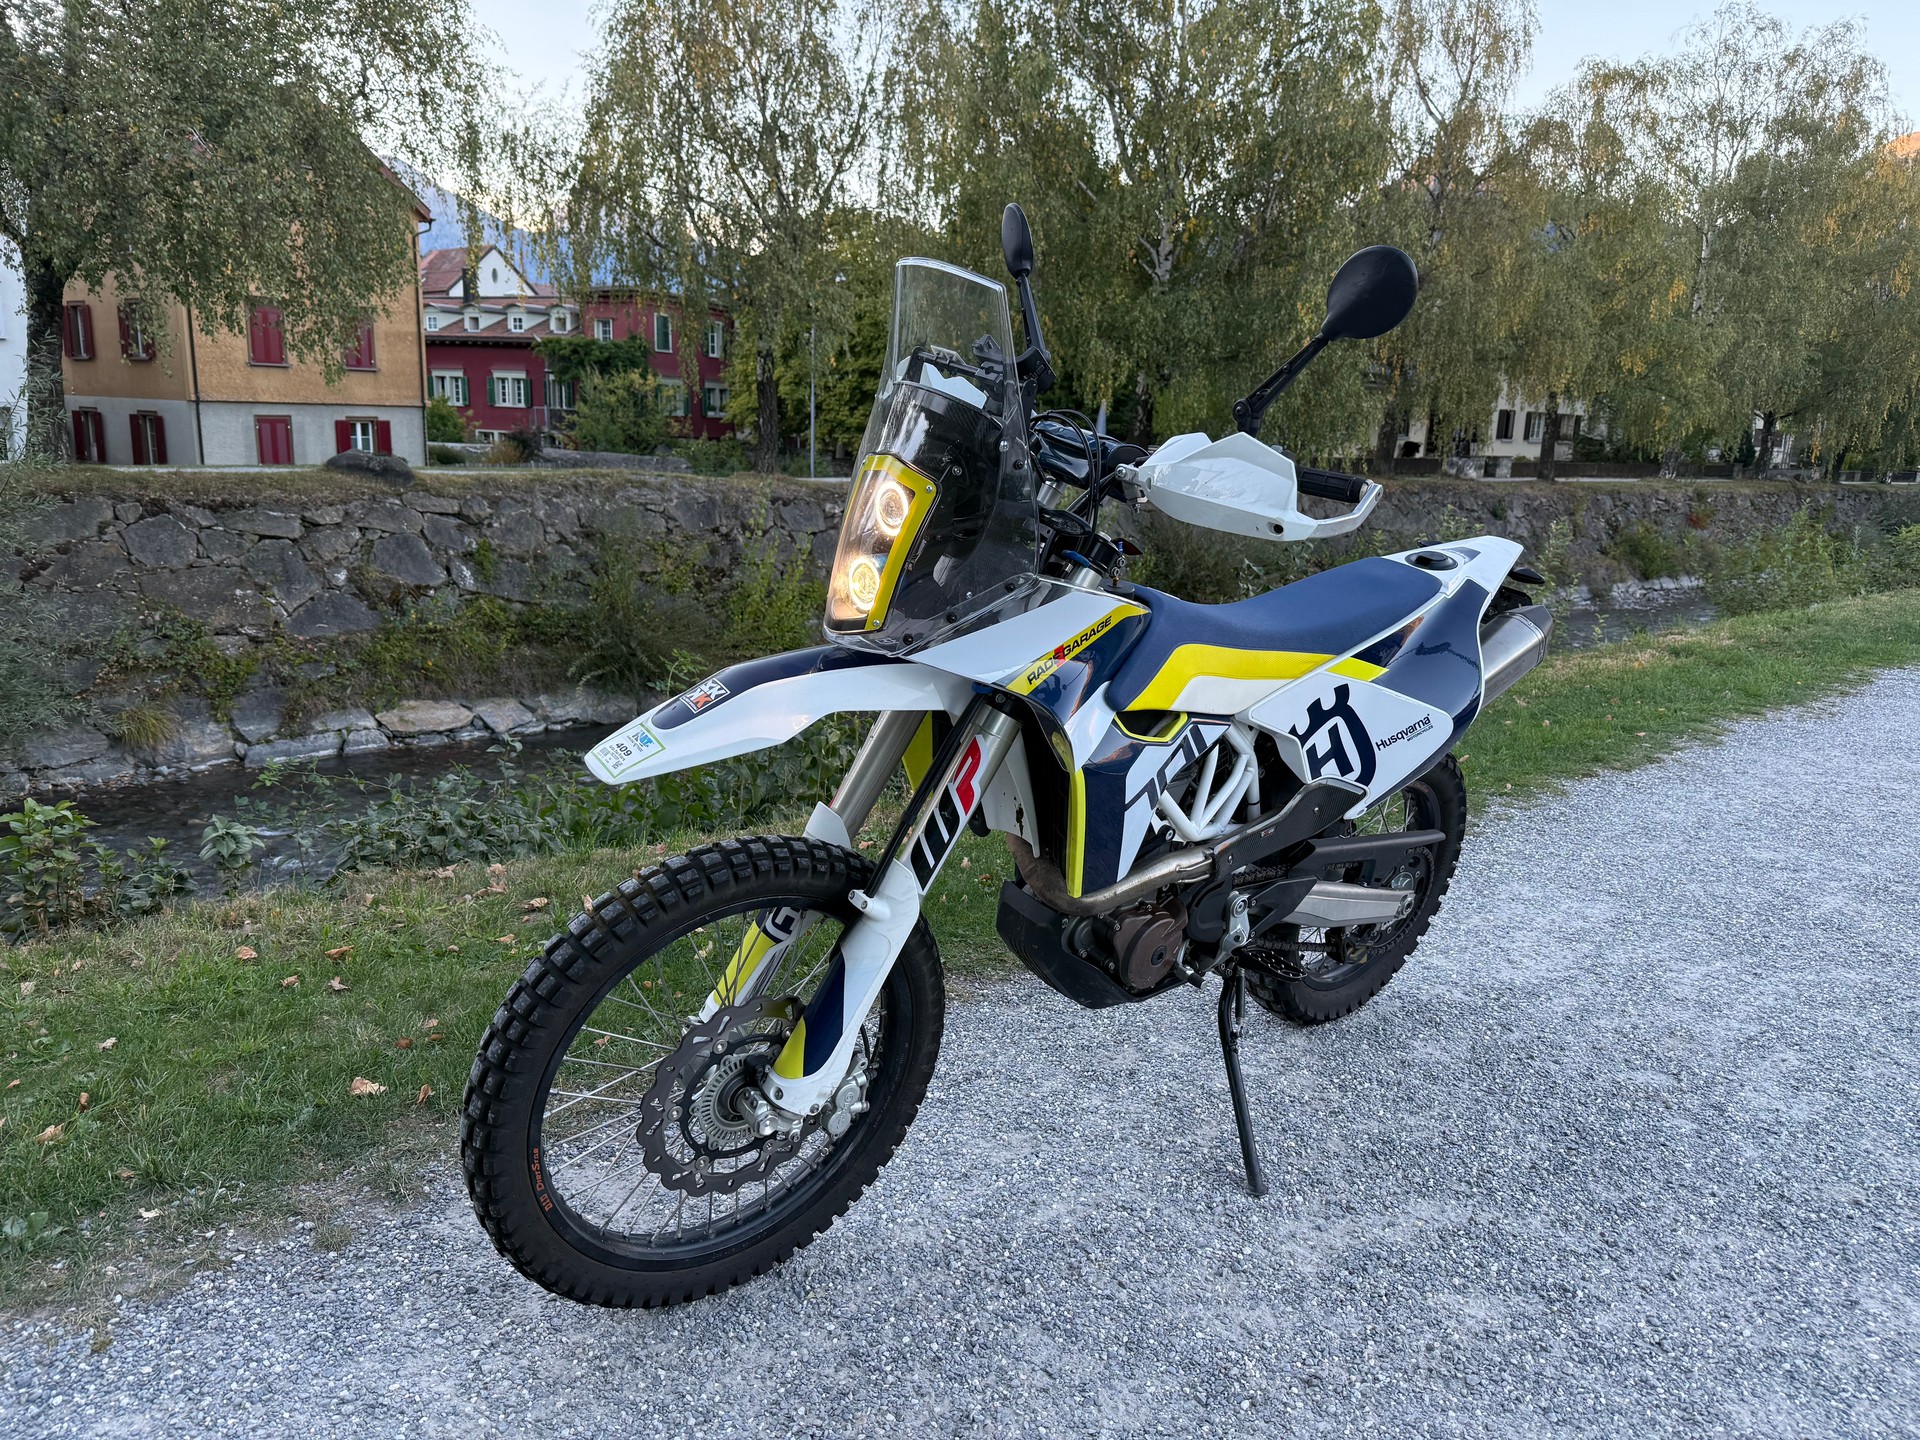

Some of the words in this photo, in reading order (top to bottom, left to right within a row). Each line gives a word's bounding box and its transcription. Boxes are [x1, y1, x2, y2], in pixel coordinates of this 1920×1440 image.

[1062, 615, 1113, 658] GARAGE
[615, 742, 633, 757] 409
[1375, 714, 1432, 752] Husqvarna
[910, 736, 982, 892] WP
